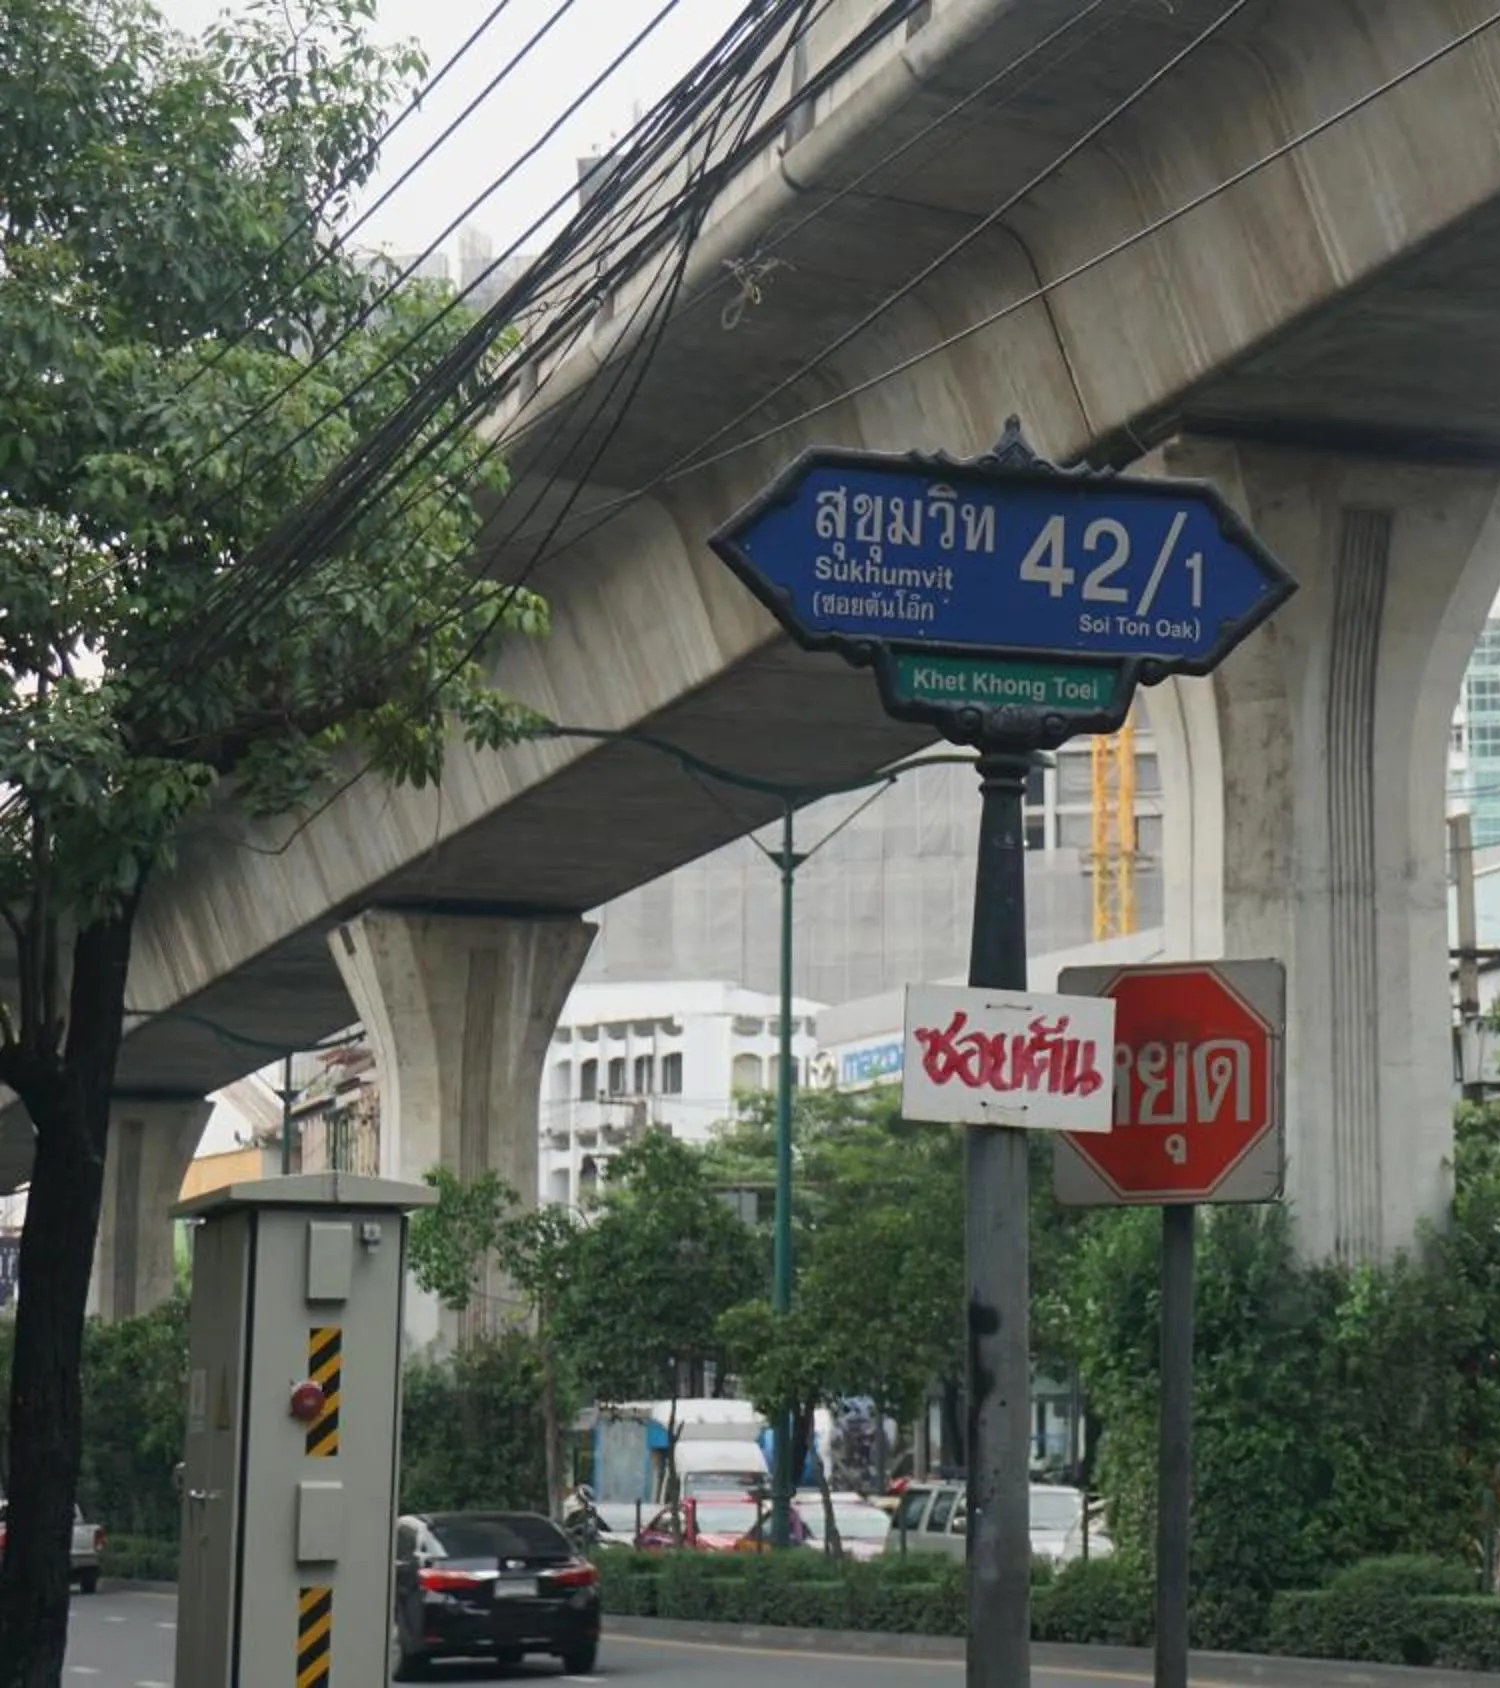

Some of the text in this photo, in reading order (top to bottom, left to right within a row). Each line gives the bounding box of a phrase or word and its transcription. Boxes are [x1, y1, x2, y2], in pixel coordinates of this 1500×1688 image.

[815, 484, 996, 564] สุขุมวิท
[815, 555, 954, 590] Sukhumvit
[1079, 613, 1201, 643] Soi Ton Oak)
[913, 667, 1099, 702] Khet Khong Toei
